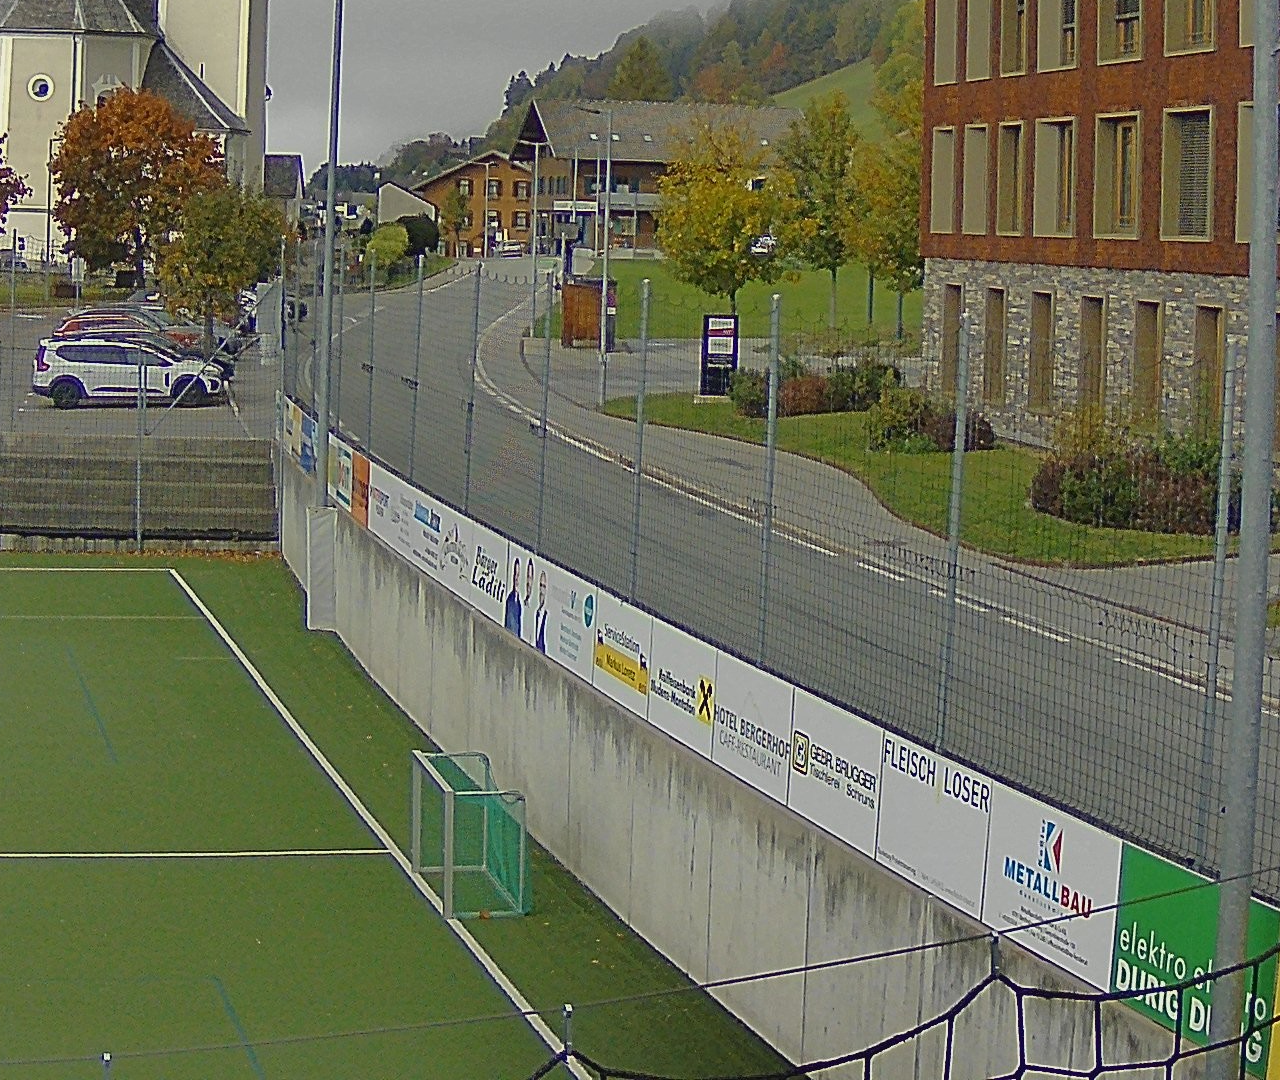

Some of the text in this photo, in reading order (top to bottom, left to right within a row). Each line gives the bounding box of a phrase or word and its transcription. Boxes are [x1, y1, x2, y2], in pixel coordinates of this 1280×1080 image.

[715, 704, 738, 733] HOTEL
[740, 718, 791, 760] BERGERHOF
[809, 762, 840, 789] Tischlerei
[884, 738, 990, 813] FLEISCH LOSER
[1004, 856, 1093, 918] METALLBAU
[1120, 921, 1187, 980] elektro
